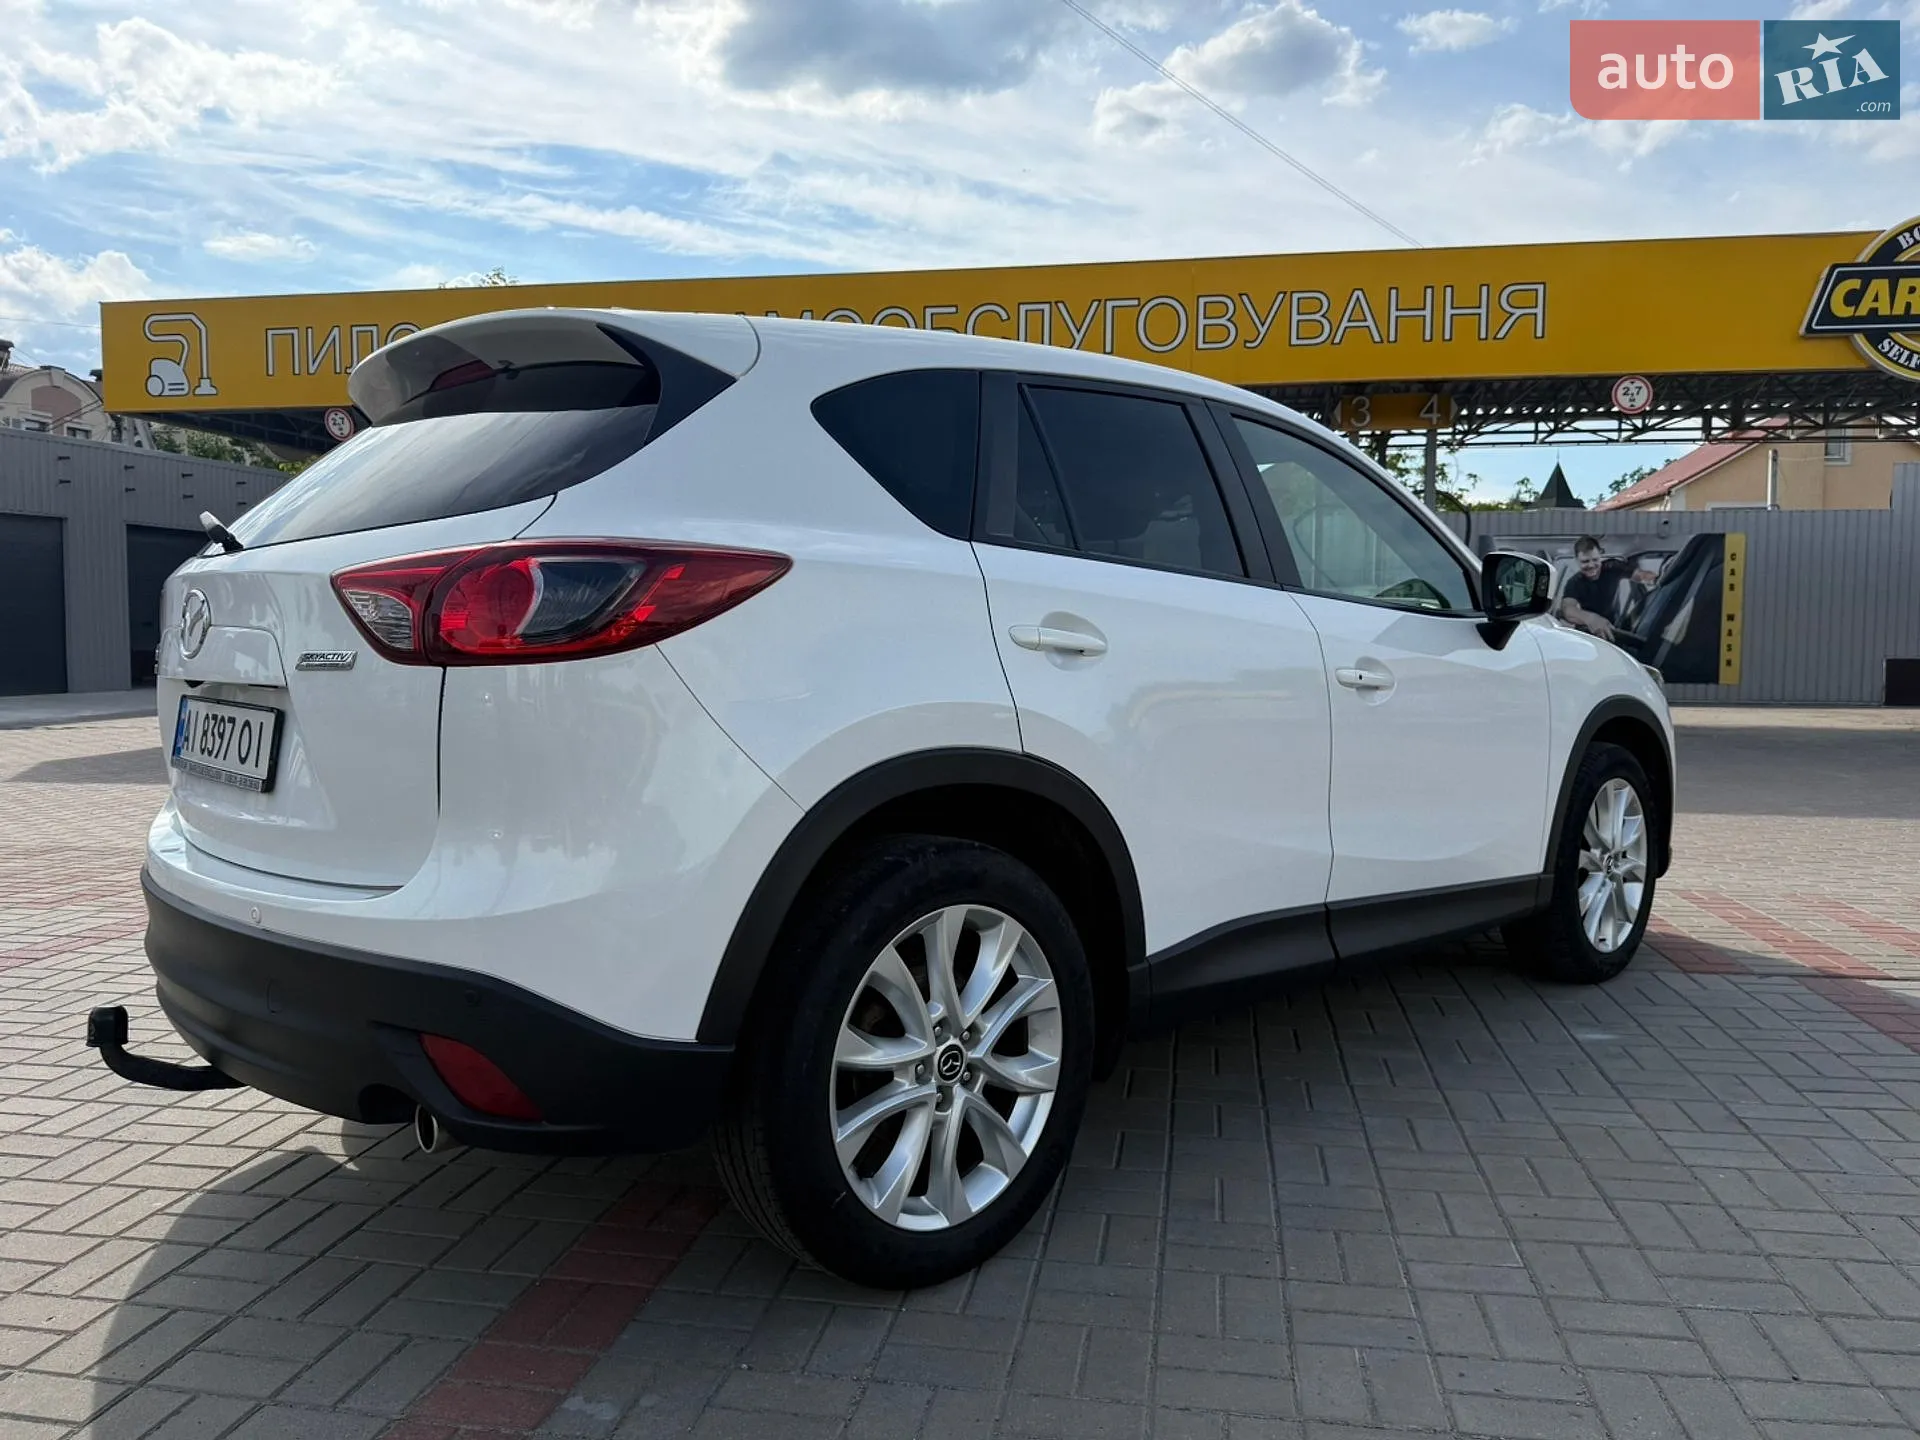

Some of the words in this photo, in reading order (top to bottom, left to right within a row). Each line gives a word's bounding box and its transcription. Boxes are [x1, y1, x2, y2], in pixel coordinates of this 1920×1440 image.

[1829, 277, 1920, 318] CAR
[1622, 385, 1643, 397] 2,7
[1350, 396, 1371, 427] 3
[1419, 394, 1441, 425] 4
[1729, 552, 1737, 592] CAR
[182, 709, 199, 752] AI
[200, 712, 237, 761] 8397
